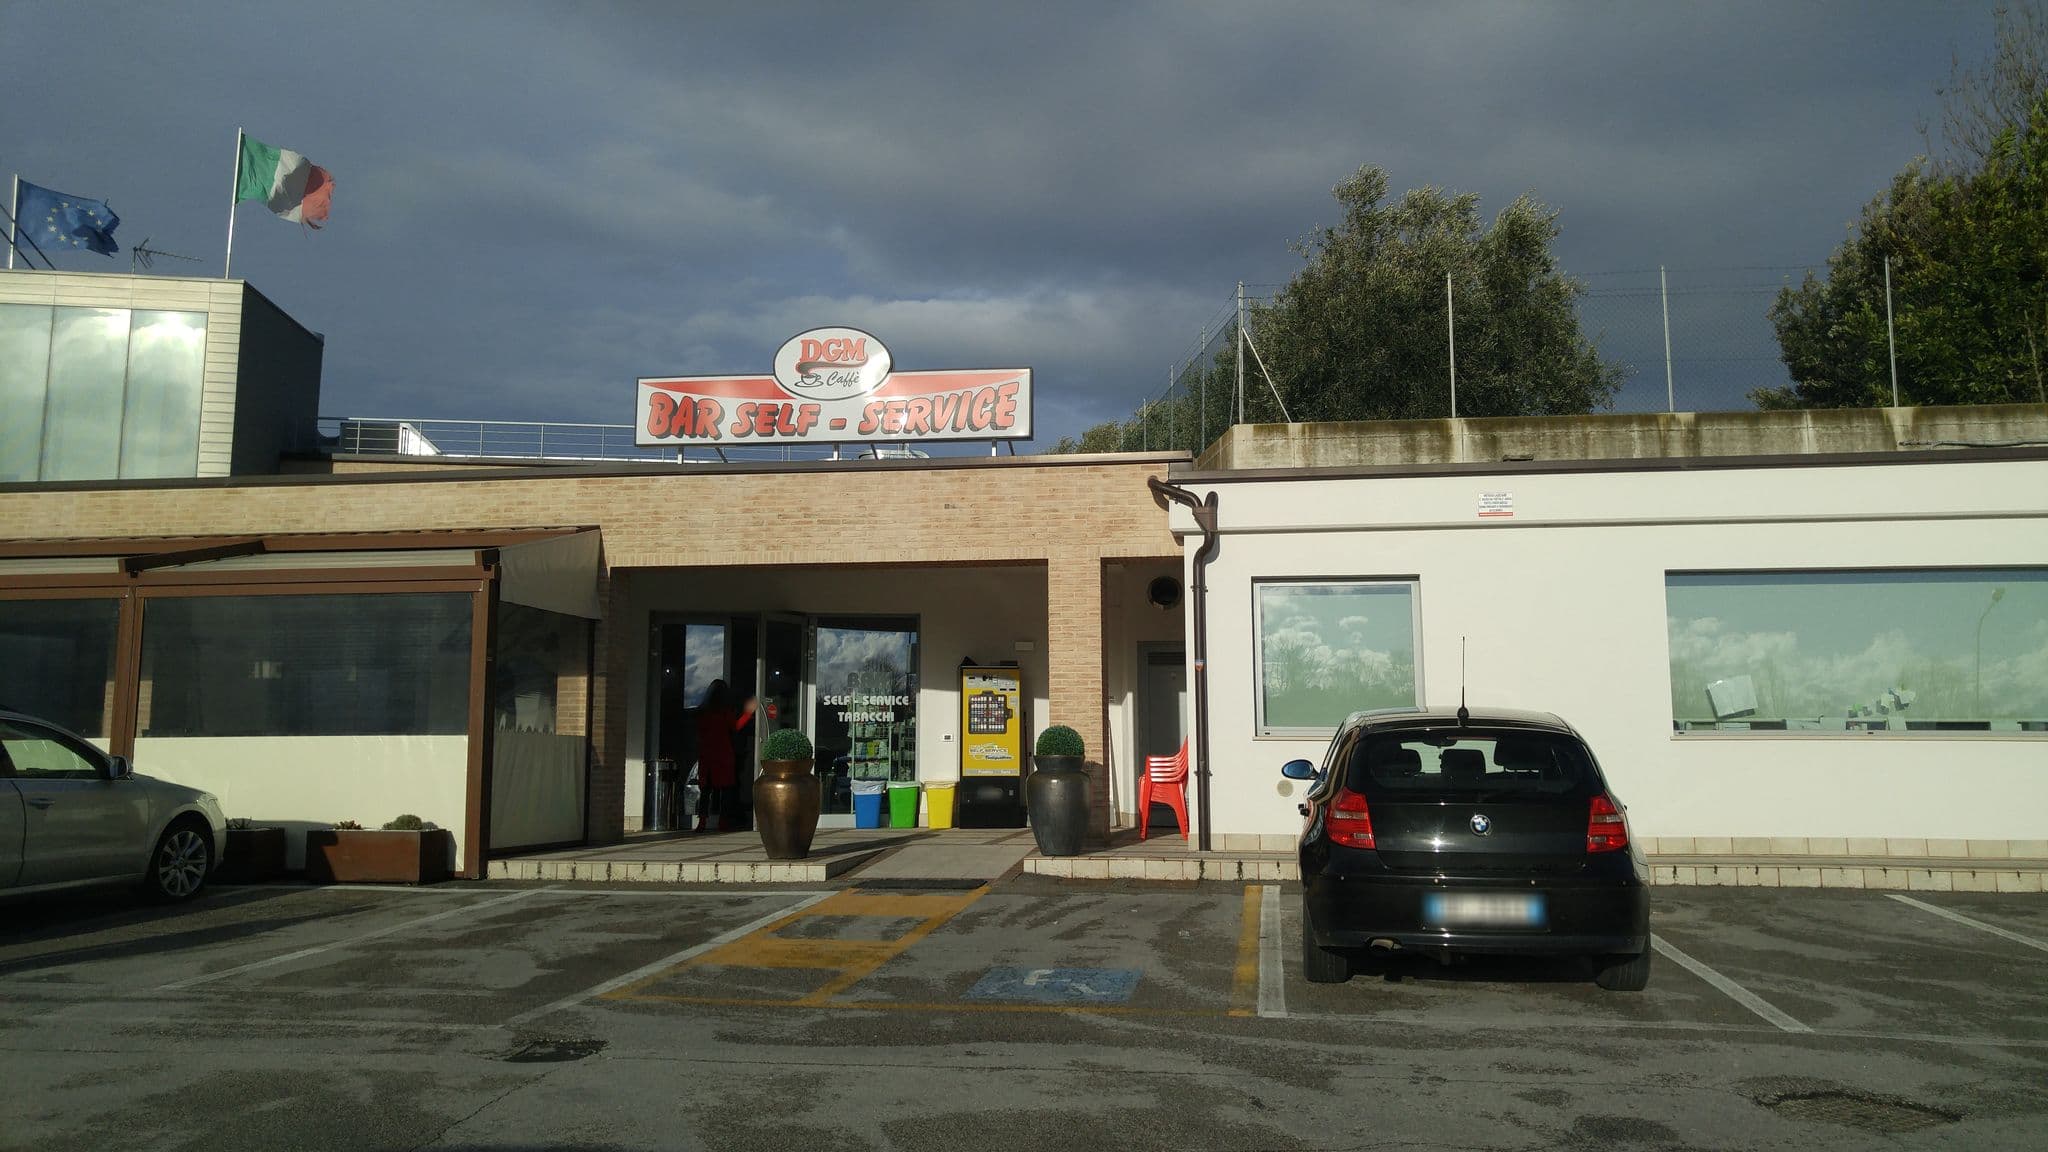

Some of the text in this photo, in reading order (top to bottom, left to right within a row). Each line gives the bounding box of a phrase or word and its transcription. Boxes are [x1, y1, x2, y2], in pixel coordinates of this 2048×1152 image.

[800, 338, 866, 362] DGM
[826, 371, 860, 387] Caffè
[648, 391, 726, 440] BAR
[731, 402, 821, 438] SELF
[858, 382, 1020, 436] SERVICE
[823, 695, 850, 706] SELF
[862, 695, 909, 706] SERVICE
[837, 711, 895, 723] TABACCHI
